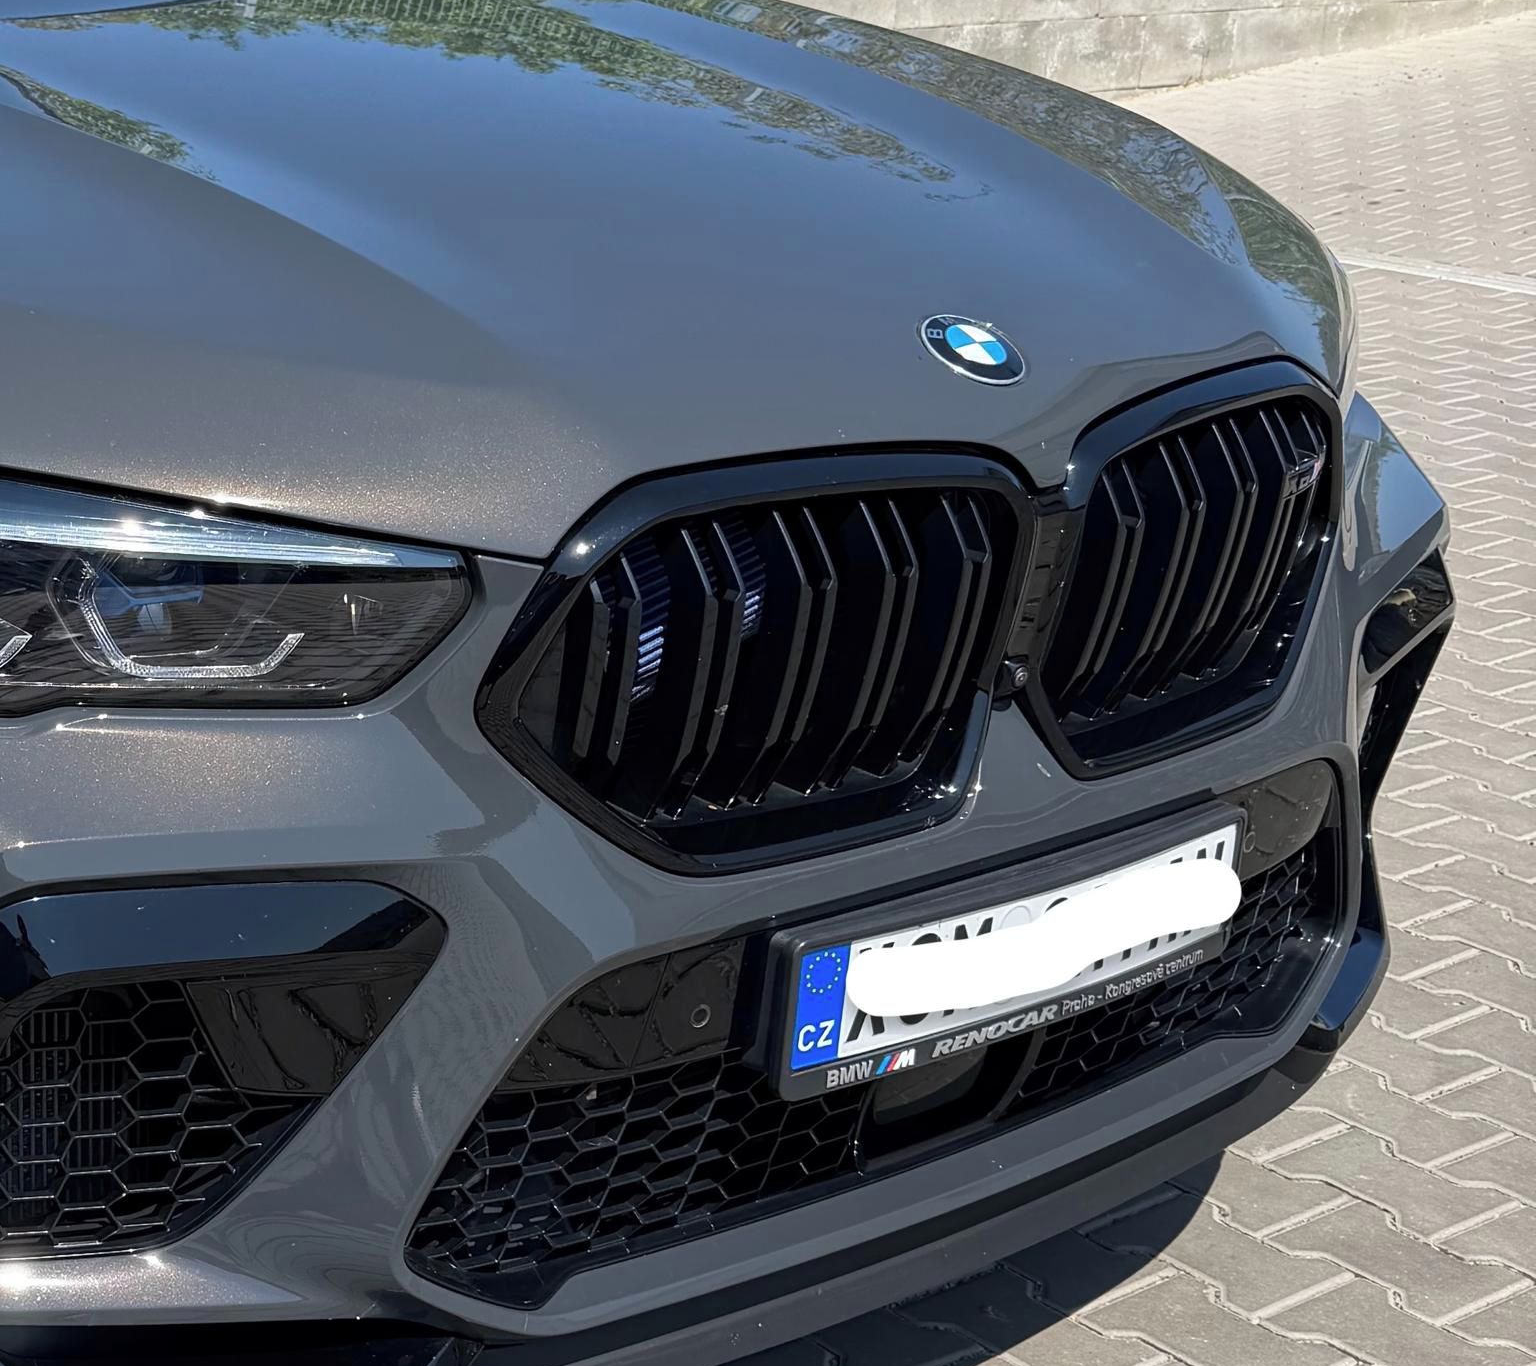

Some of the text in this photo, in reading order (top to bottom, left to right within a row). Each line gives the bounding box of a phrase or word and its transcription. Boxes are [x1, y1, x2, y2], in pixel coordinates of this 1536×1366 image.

[797, 1019, 836, 1052] CZ
[826, 1059, 874, 1089] BMW
[931, 1004, 1058, 1058] RENOCAR
[1061, 994, 1096, 1015] Praha
[1105, 963, 1164, 1000] Kongresové
[1165, 948, 1204, 975] centrum
